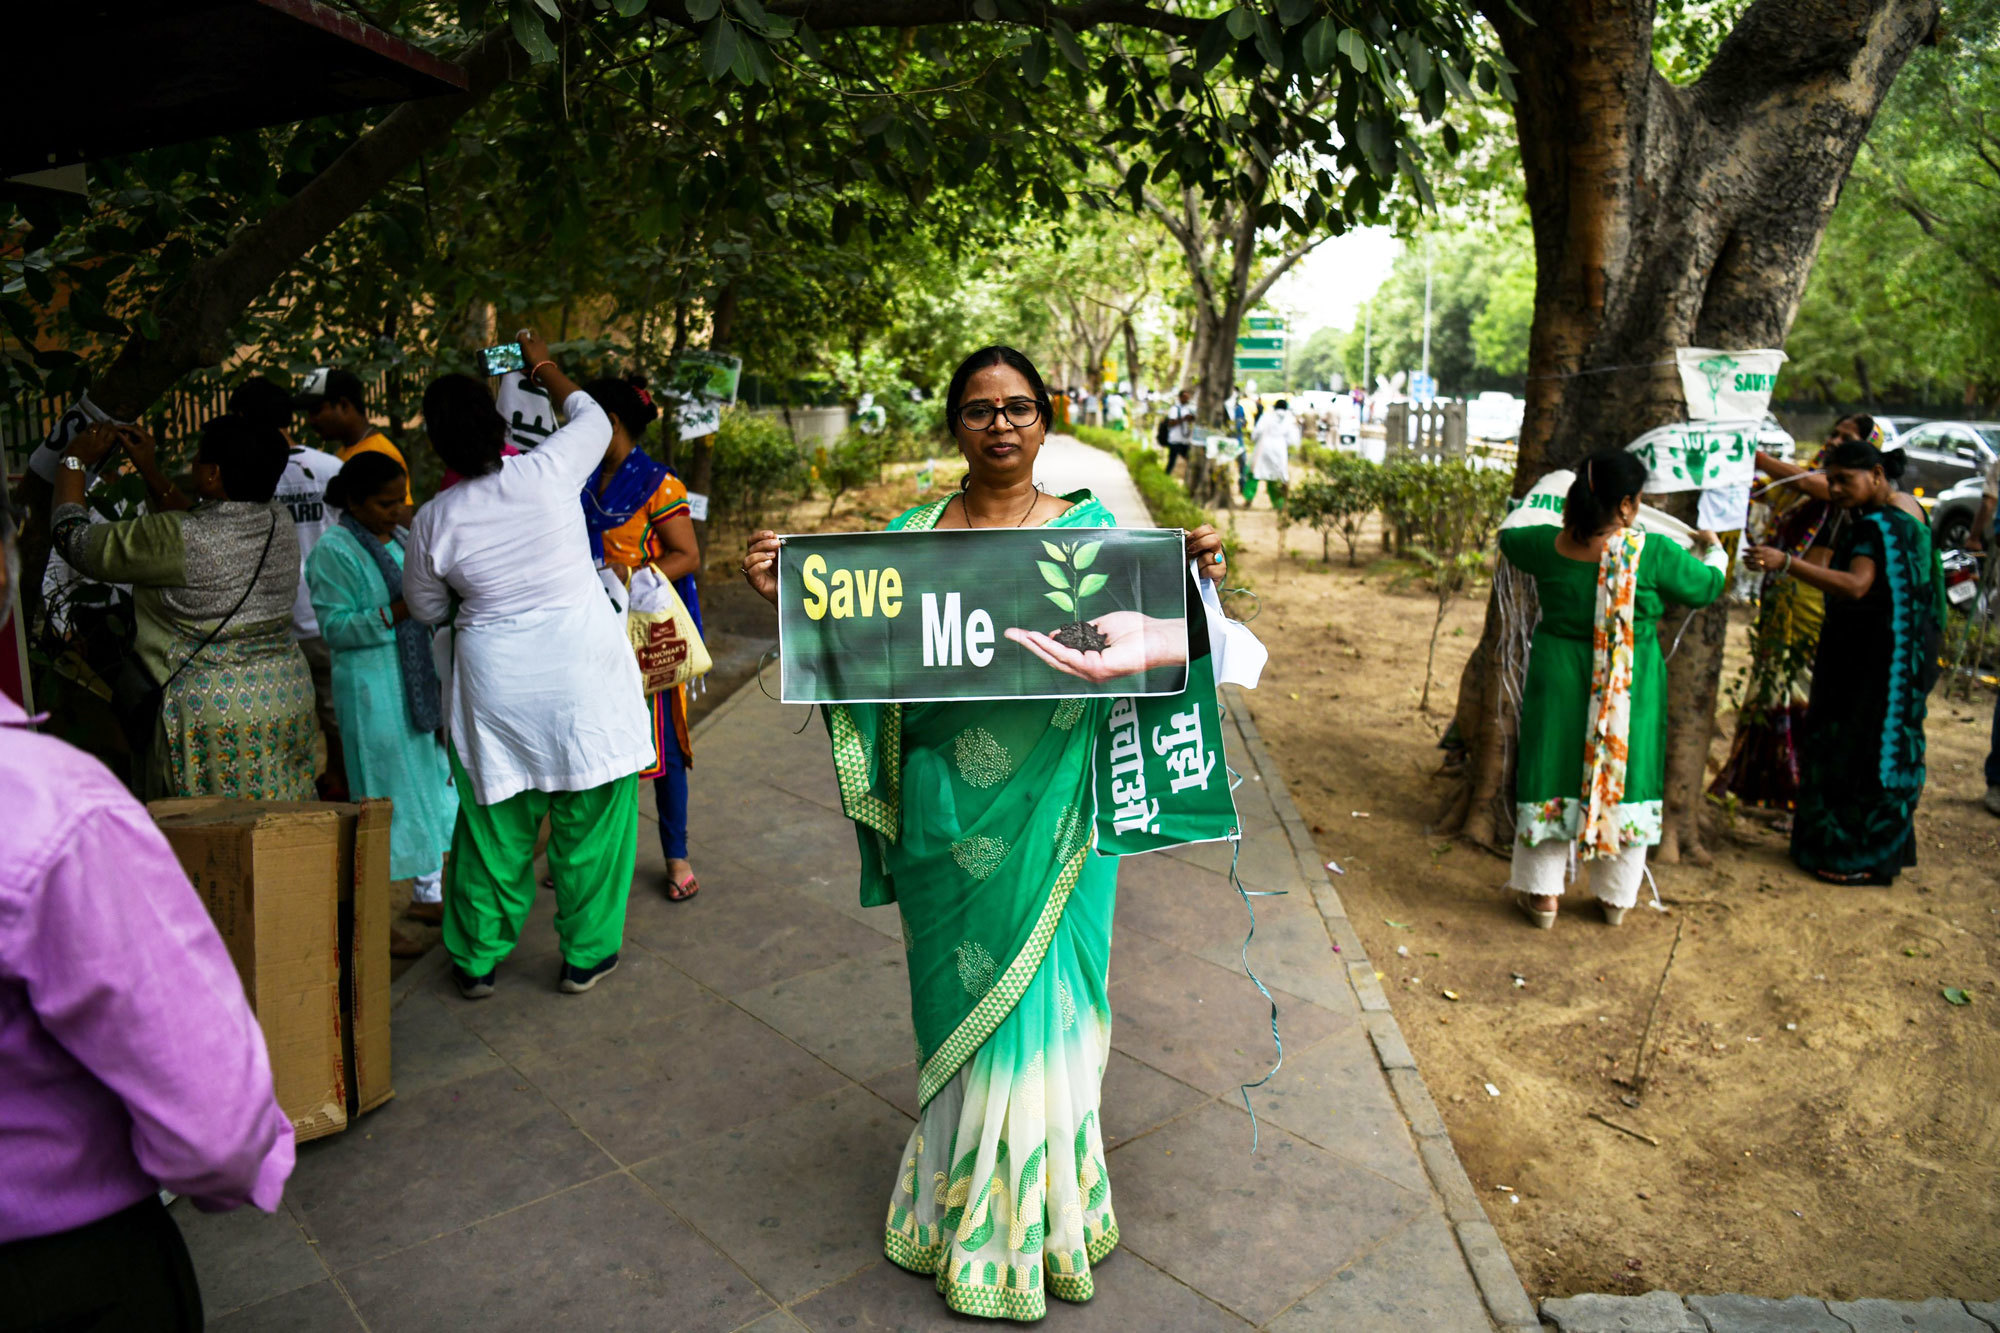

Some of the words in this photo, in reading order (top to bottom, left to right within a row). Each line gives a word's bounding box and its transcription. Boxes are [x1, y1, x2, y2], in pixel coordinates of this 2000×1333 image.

[1528, 494, 1567, 514] AVE
[802, 553, 903, 621] Save
[921, 592, 996, 668] Me
[1152, 702, 1216, 794] मुझे
